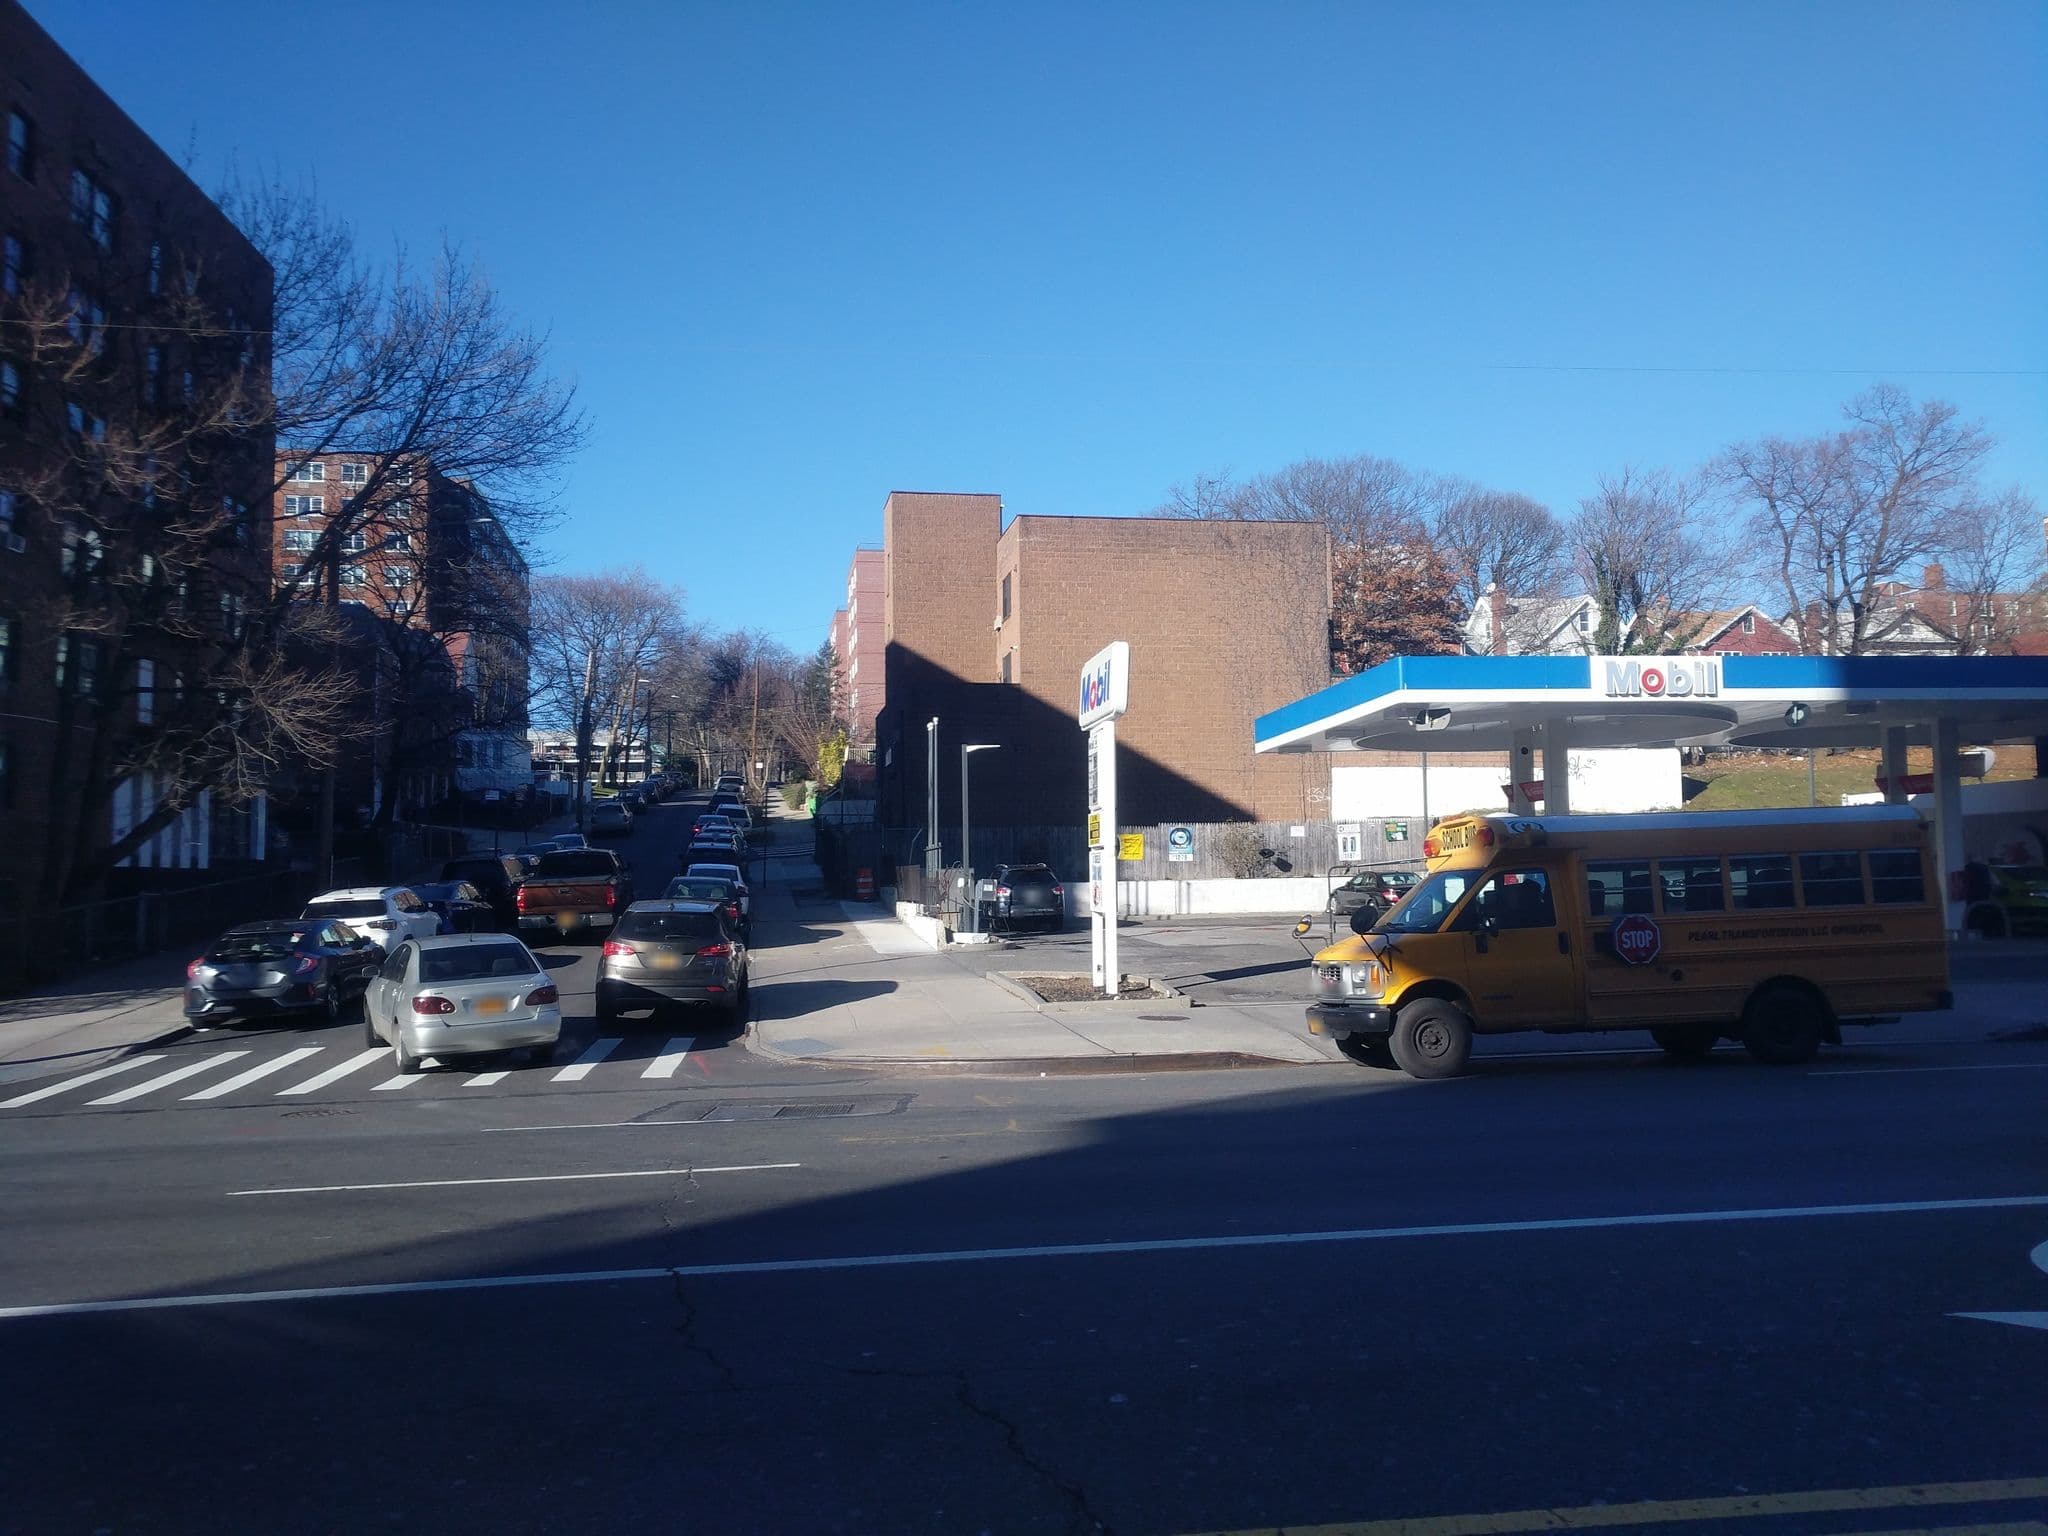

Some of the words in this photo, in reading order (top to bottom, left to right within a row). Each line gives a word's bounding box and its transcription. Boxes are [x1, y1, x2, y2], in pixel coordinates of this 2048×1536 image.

[1081, 659, 1110, 715] Mobil
[1605, 661, 1718, 697] Mobil
[1442, 829, 1464, 851] SCHOOL
[1621, 930, 1654, 949] STOP
